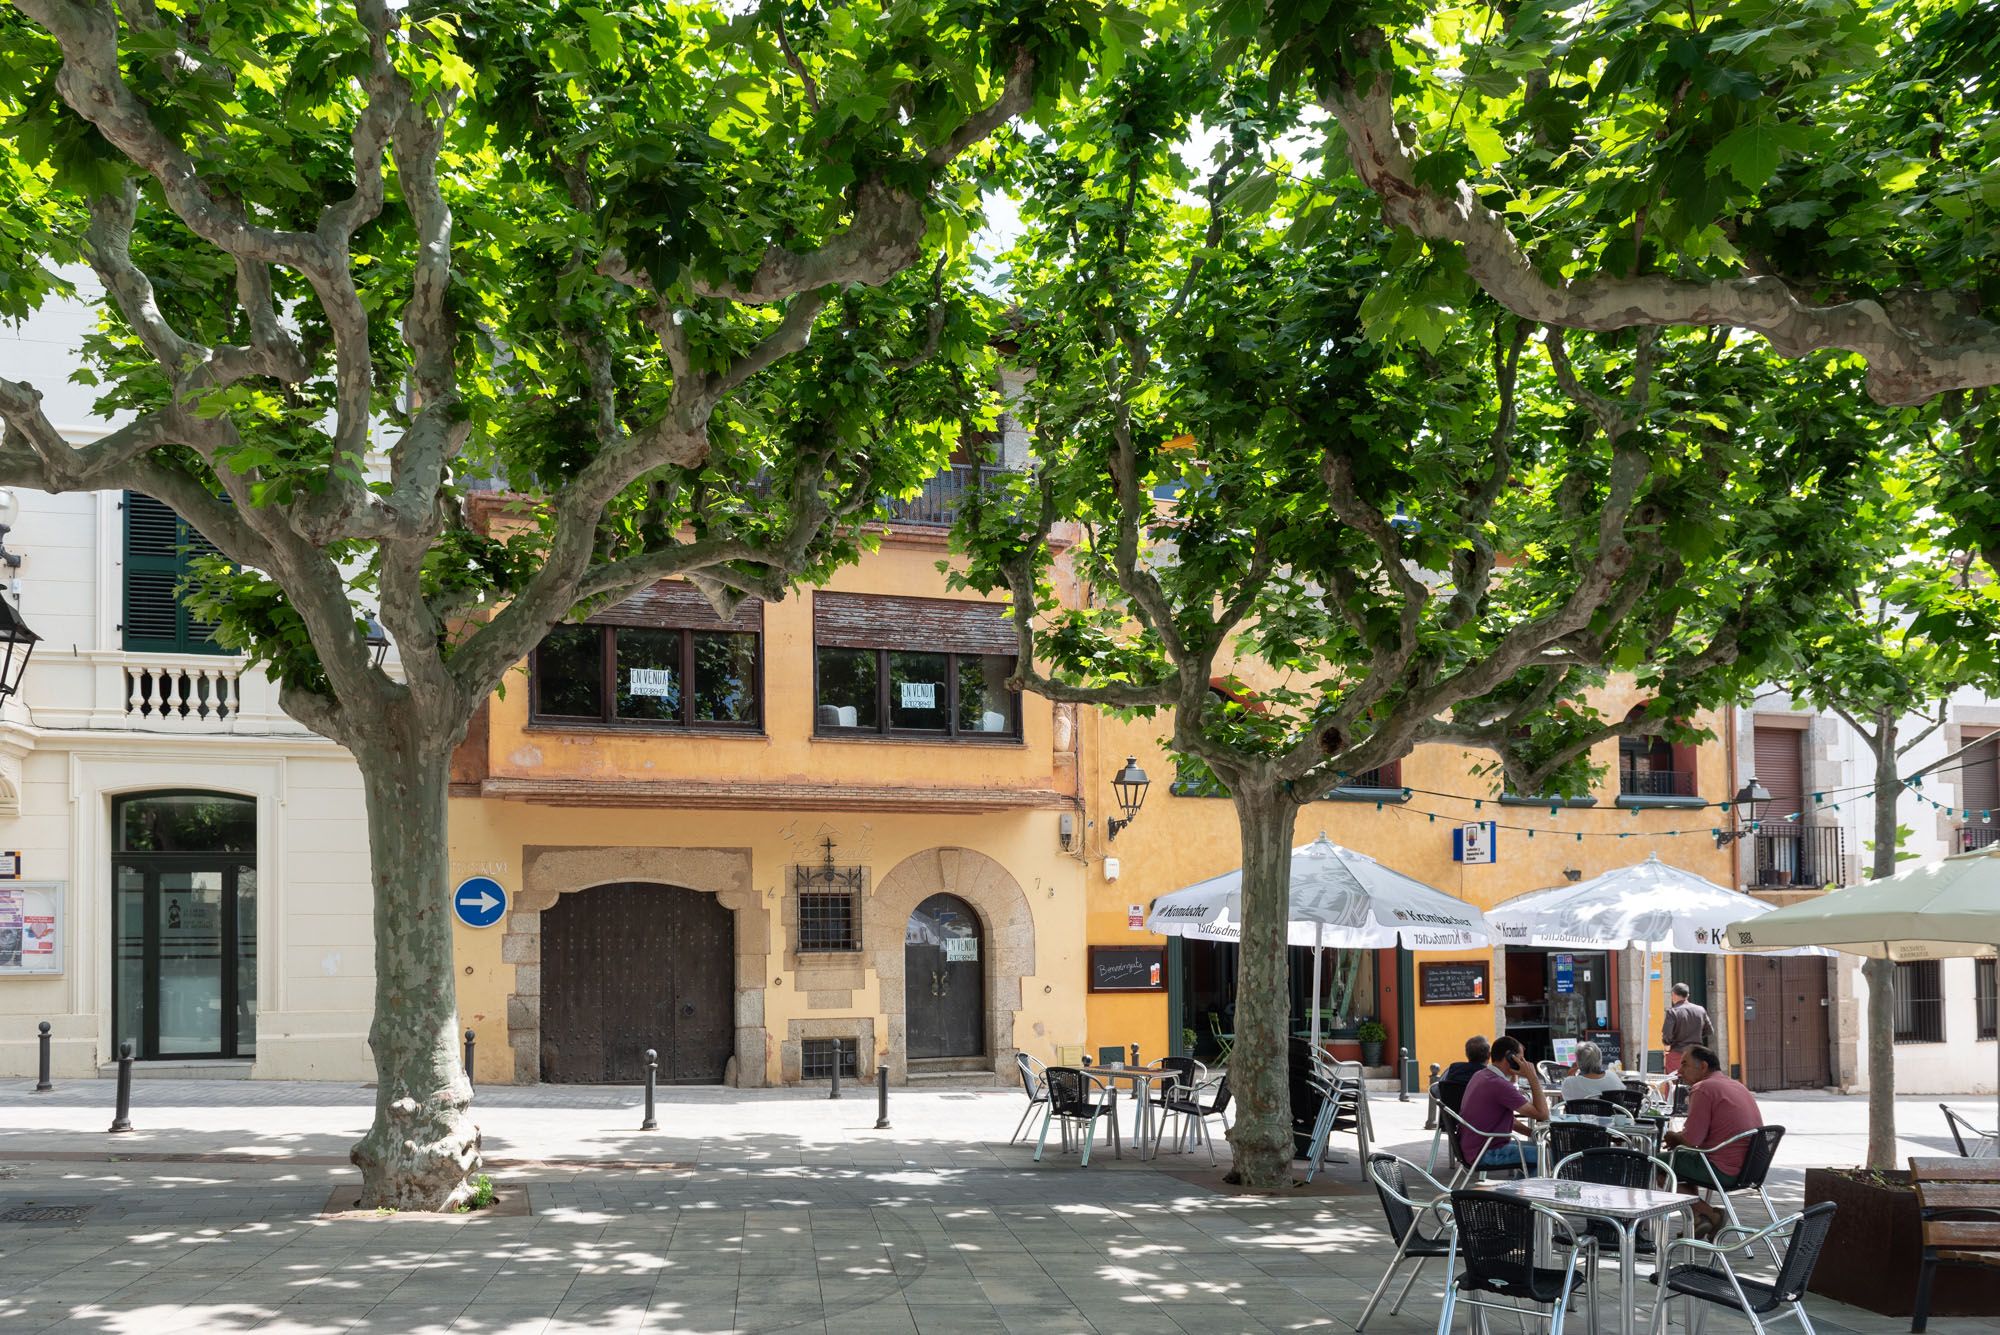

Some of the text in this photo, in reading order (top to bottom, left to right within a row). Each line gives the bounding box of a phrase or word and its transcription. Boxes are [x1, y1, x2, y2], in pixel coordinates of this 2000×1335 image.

[631, 669, 667, 685] EN VENDA
[902, 684, 934, 698] EN VENDA
[1164, 904, 1209, 917] Krombacher
[1406, 909, 1472, 927] Krombacher
